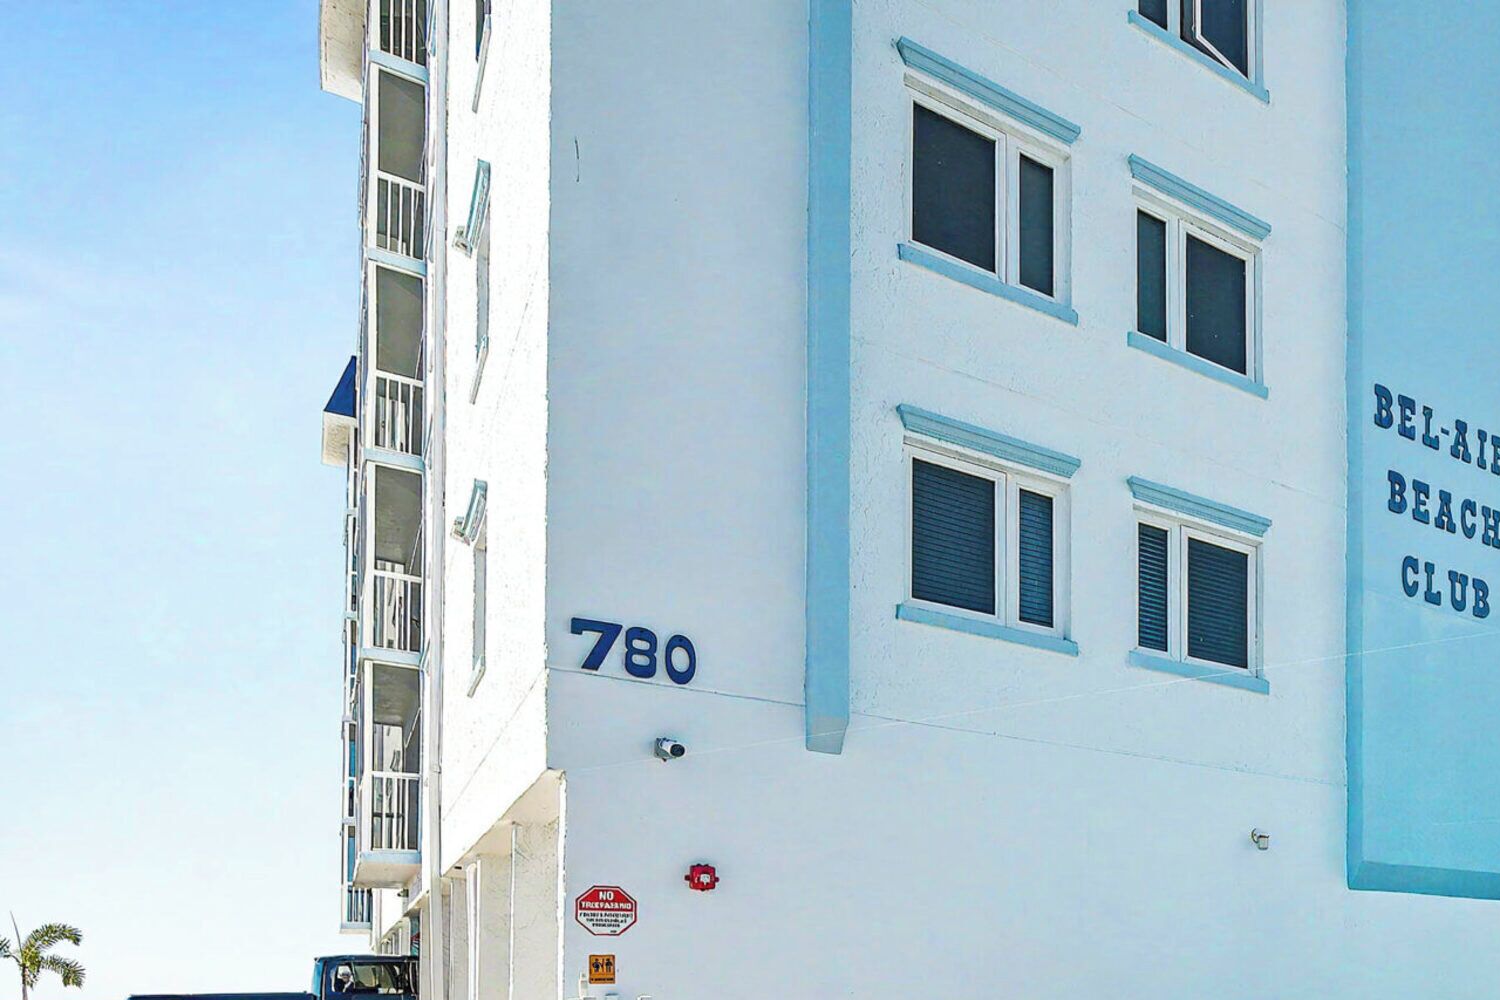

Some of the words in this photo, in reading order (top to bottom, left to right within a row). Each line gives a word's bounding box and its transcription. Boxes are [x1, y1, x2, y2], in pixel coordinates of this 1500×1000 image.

[1402, 555, 1490, 619] CLUB
[570, 617, 697, 685] 780
[599, 891, 614, 901] NO
